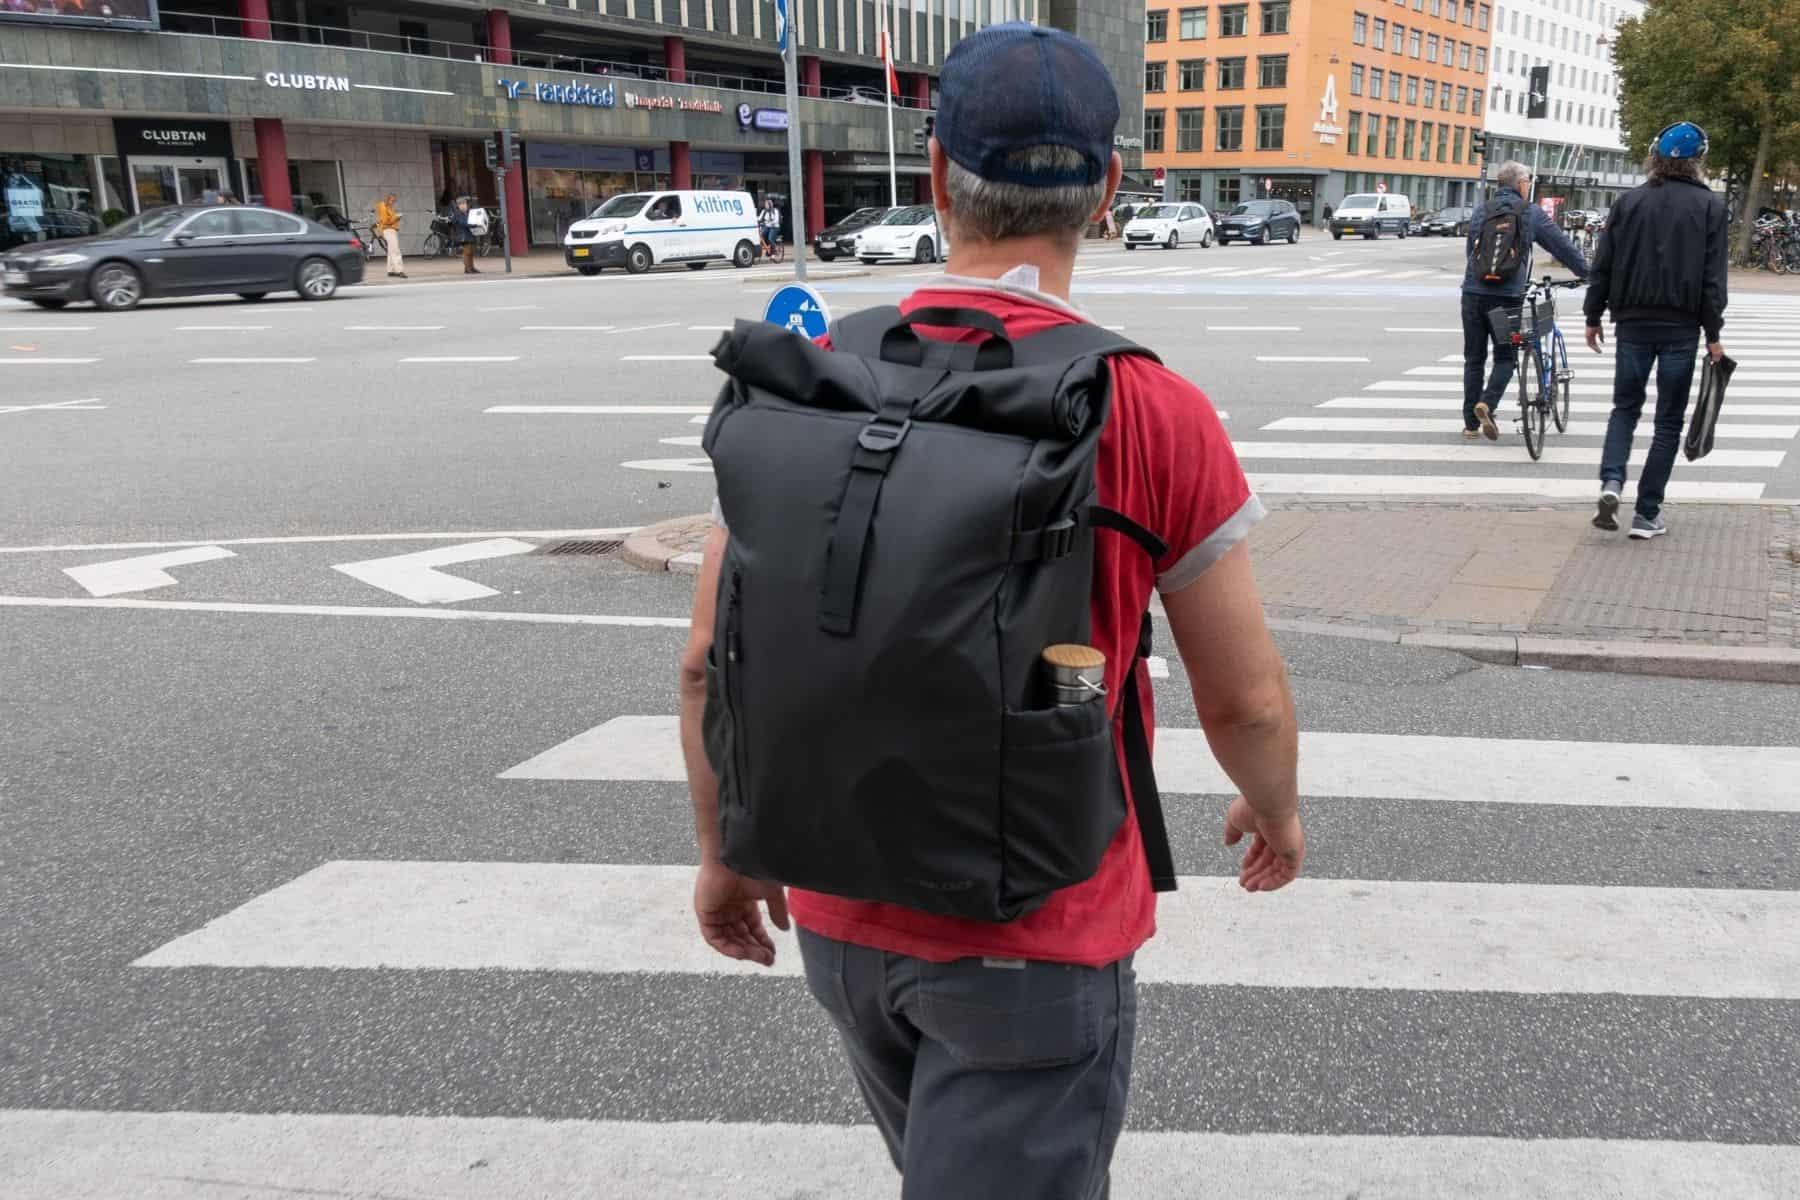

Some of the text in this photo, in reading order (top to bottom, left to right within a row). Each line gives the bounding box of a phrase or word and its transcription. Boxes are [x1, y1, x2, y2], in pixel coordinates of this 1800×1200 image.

[265, 72, 350, 92] CLUBTAN
[535, 79, 615, 108] randstad
[142, 129, 207, 142] CLUBTAN
[693, 194, 743, 216] kilting
